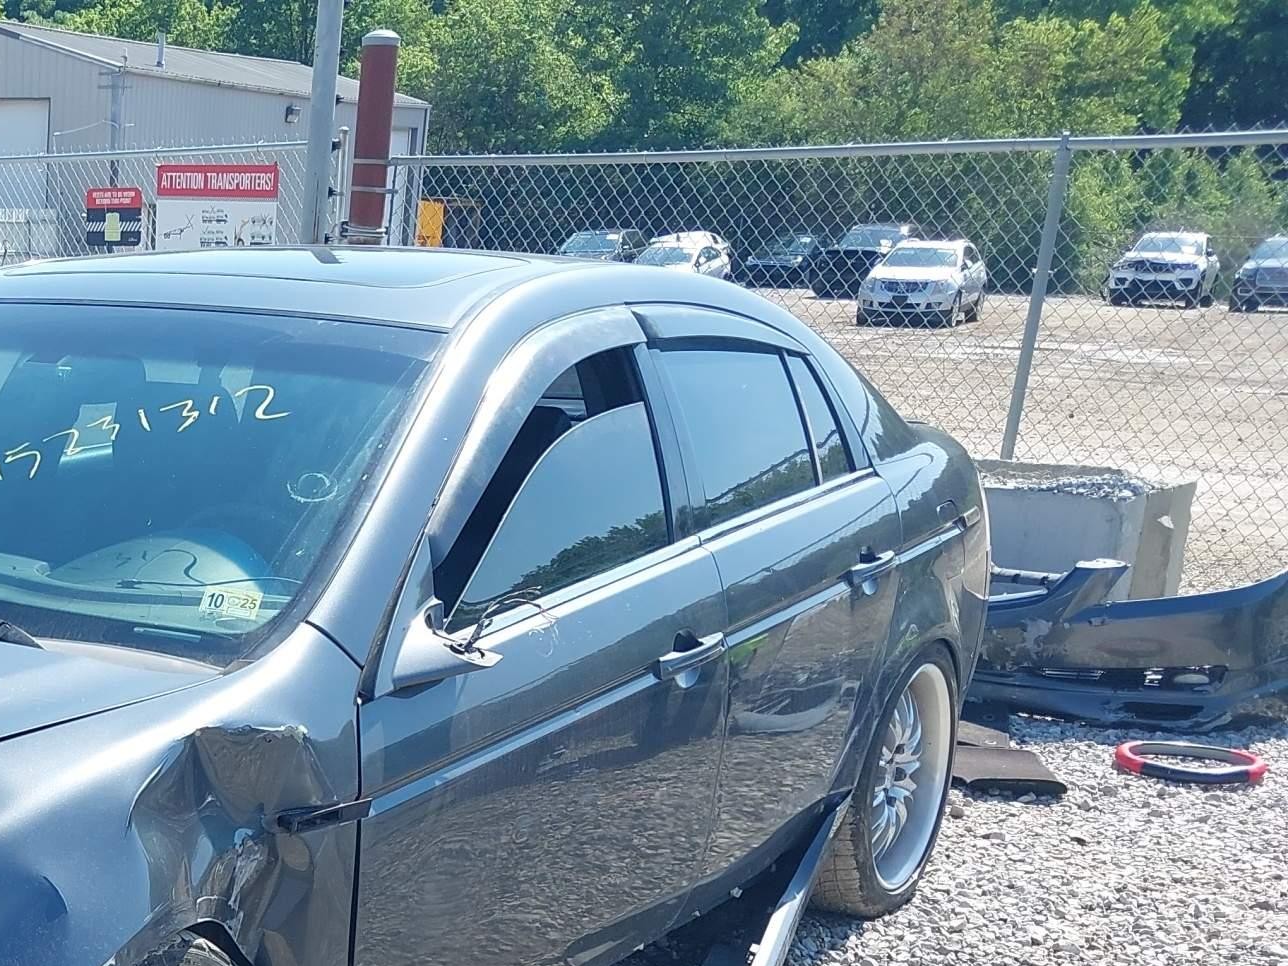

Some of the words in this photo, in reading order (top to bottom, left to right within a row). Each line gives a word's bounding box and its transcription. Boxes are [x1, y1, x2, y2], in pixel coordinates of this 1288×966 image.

[160, 172, 205, 189] ATTENTION
[206, 172, 275, 191] TRANSPORTERS!
[207, 592, 225, 609] 10
[239, 598, 258, 610] 25
